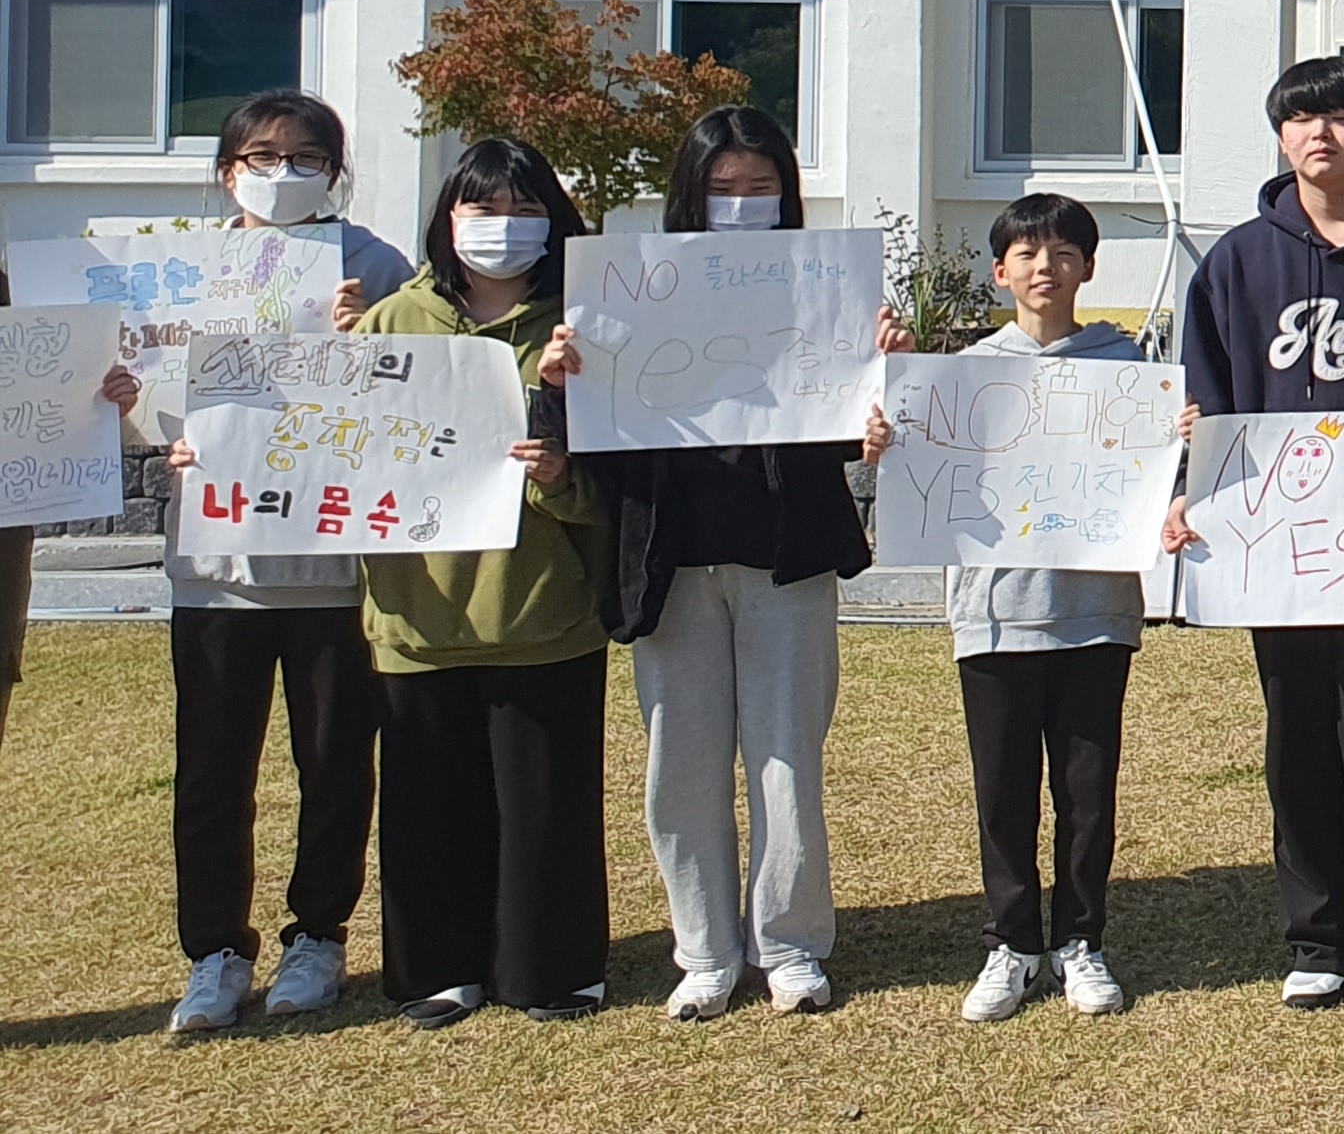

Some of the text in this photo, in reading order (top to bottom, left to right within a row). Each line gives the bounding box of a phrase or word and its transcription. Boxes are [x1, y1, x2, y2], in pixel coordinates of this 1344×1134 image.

[603, 259, 679, 303] NO
[704, 254, 788, 290] 플라스틱
[267, 401, 457, 472] 종착점은
[926, 380, 1031, 452] NO
[905, 459, 1141, 538] YES 전기차
[1211, 423, 1334, 516] NO
[202, 481, 400, 539] 나의 몸 속
